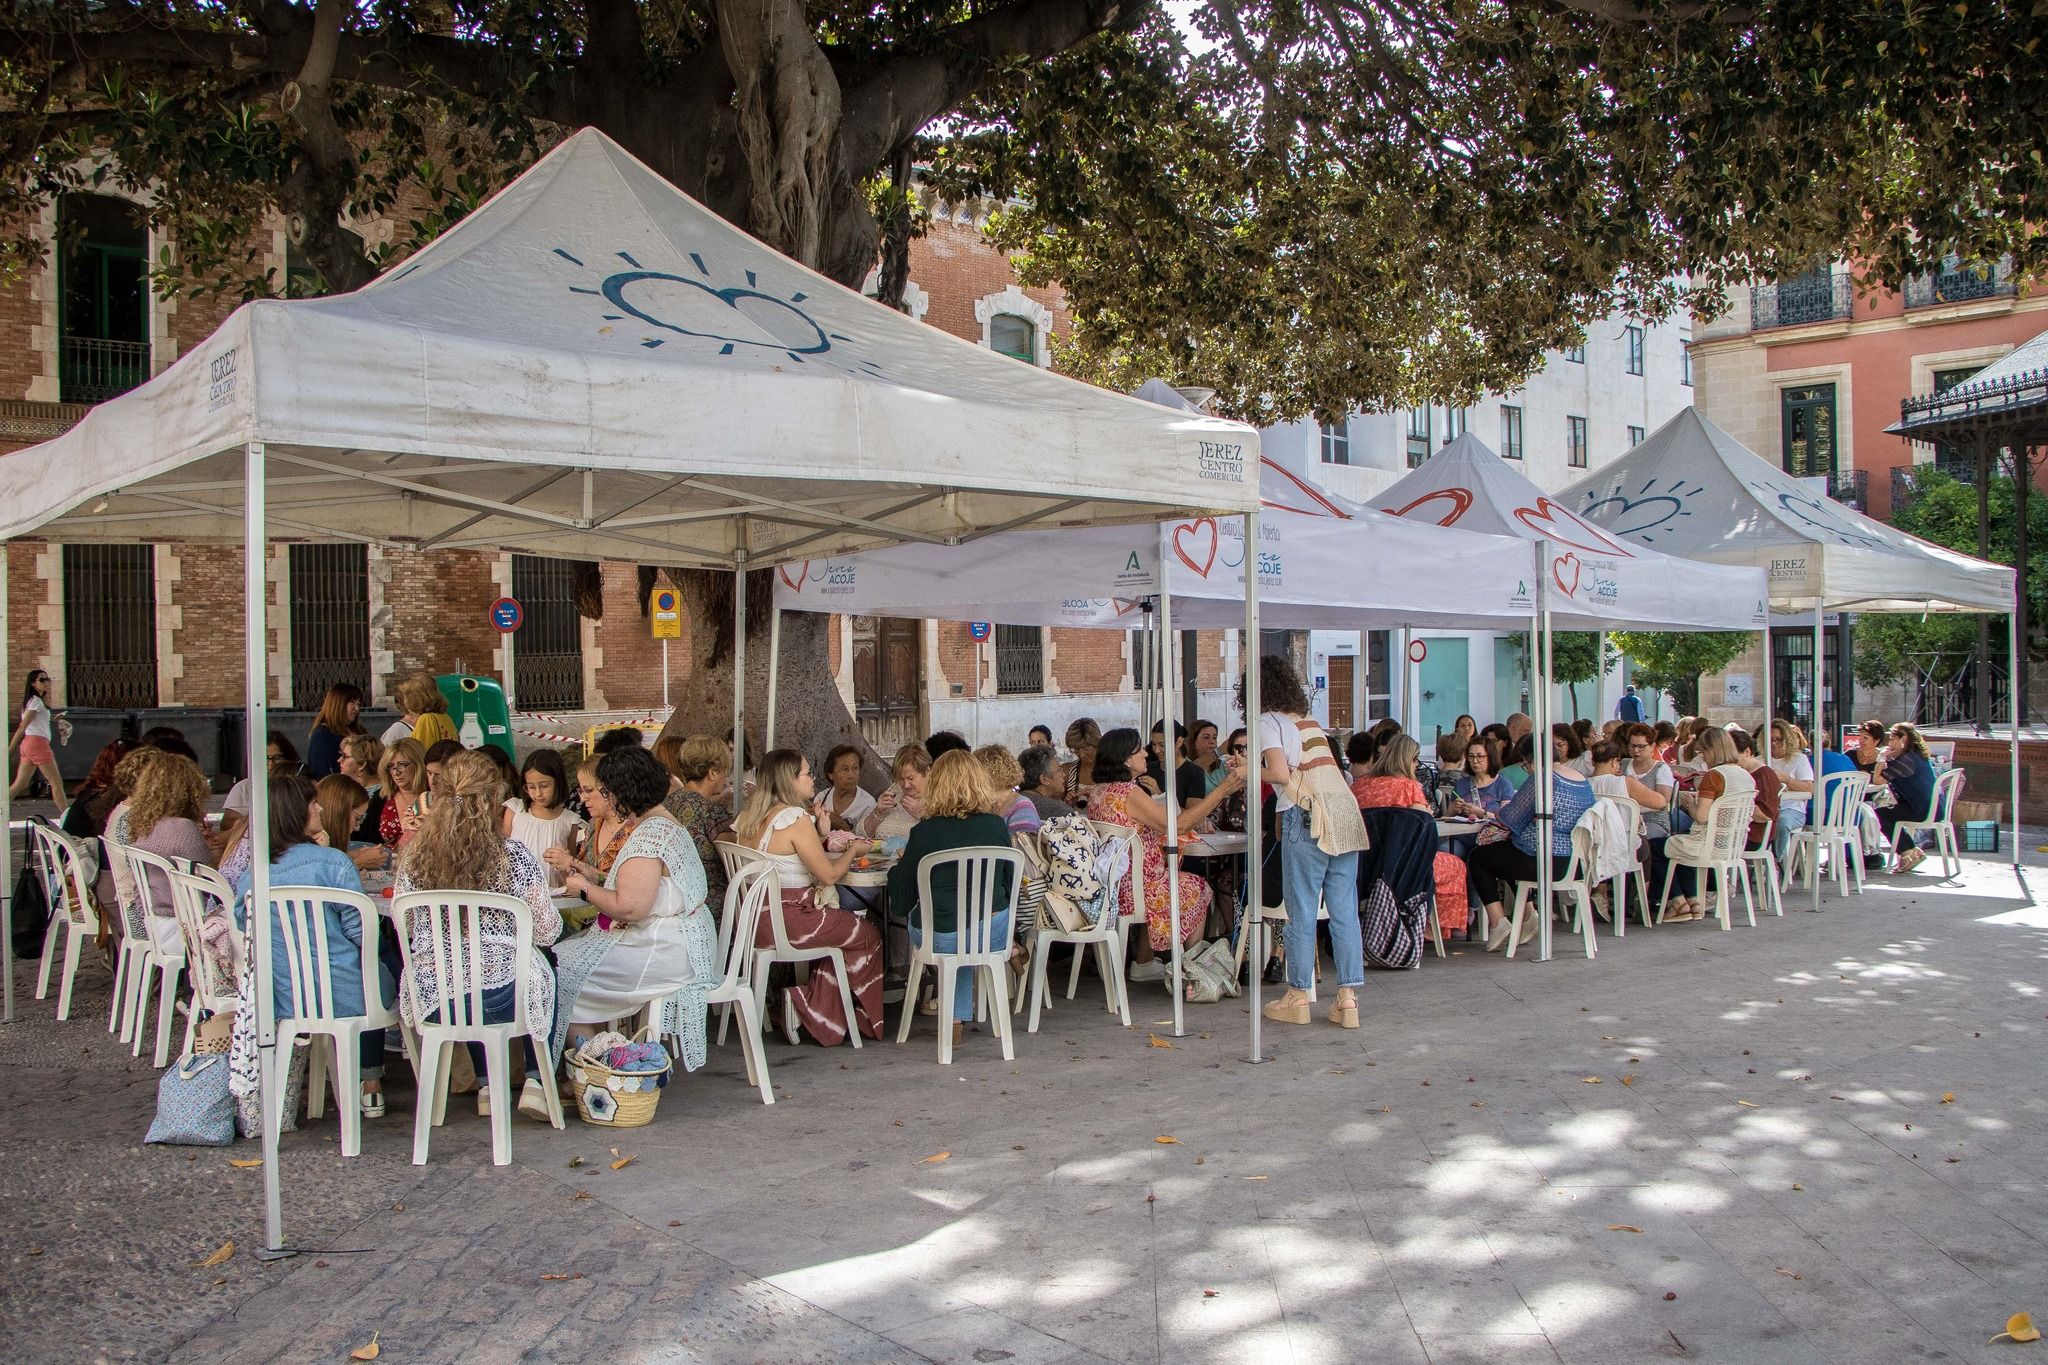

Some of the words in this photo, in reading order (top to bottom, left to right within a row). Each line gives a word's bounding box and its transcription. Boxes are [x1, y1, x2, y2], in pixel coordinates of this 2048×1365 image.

[211, 349, 236, 384] JEREZ
[1198, 441, 1242, 461] JEREZ
[1200, 459, 1242, 473] CENTRO
[1199, 470, 1243, 482] COMERCIAL
[1770, 559, 1806, 571] JEREZ
[829, 574, 855, 585] ACOJE
[1598, 587, 1617, 597] ACOJE
